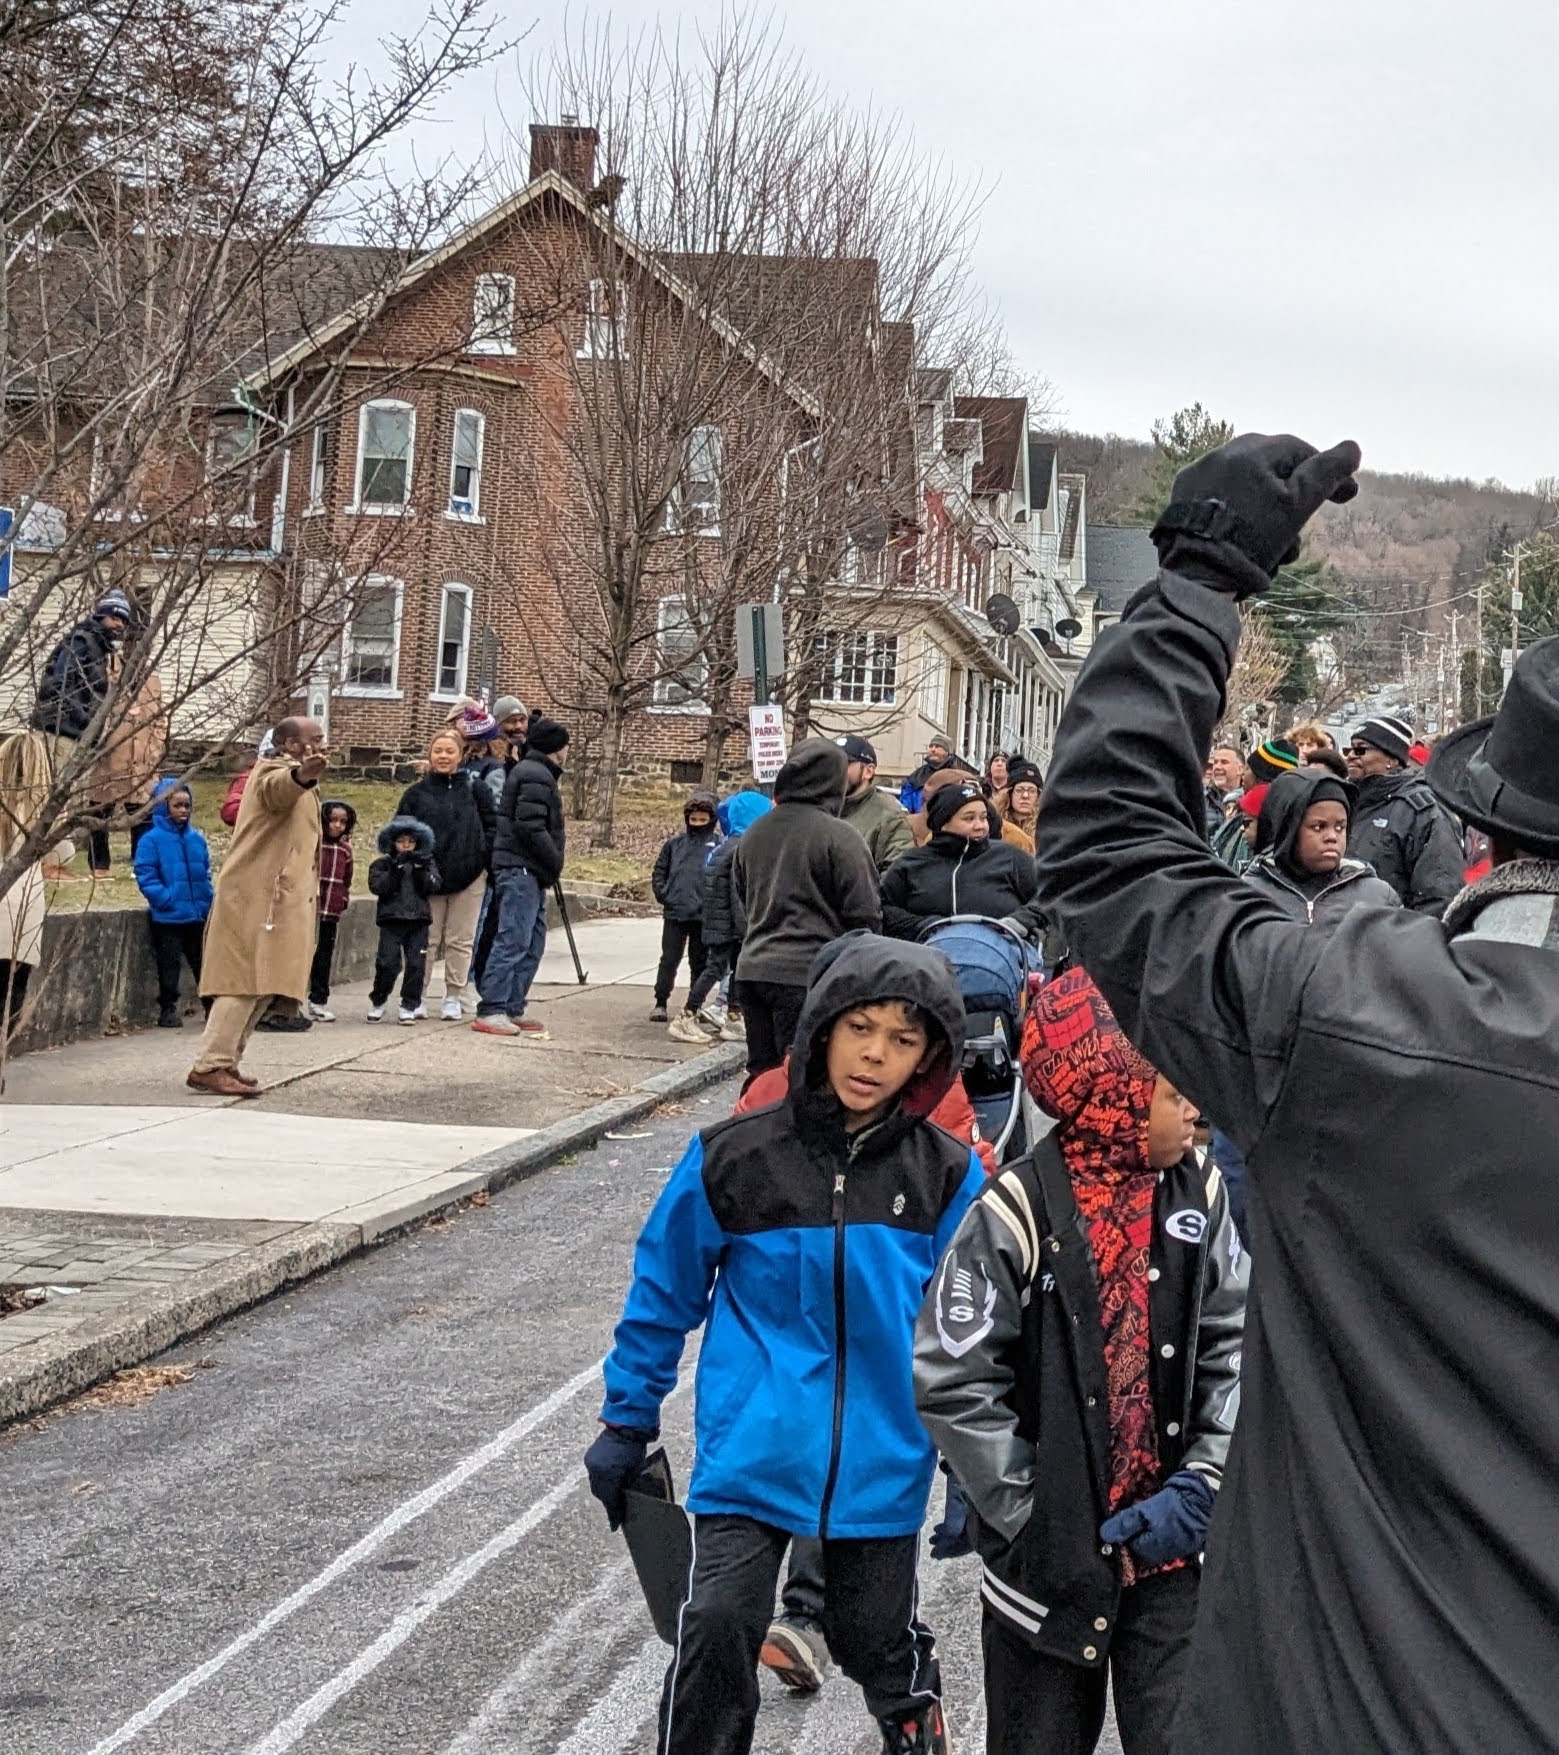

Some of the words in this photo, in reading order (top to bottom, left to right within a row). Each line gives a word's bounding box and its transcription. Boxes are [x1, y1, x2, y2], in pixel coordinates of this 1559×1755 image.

[764, 713, 774, 724] NO
[754, 726, 783, 737] PARKING
[1176, 1214, 1202, 1238] S
[948, 1305, 975, 1323] S
